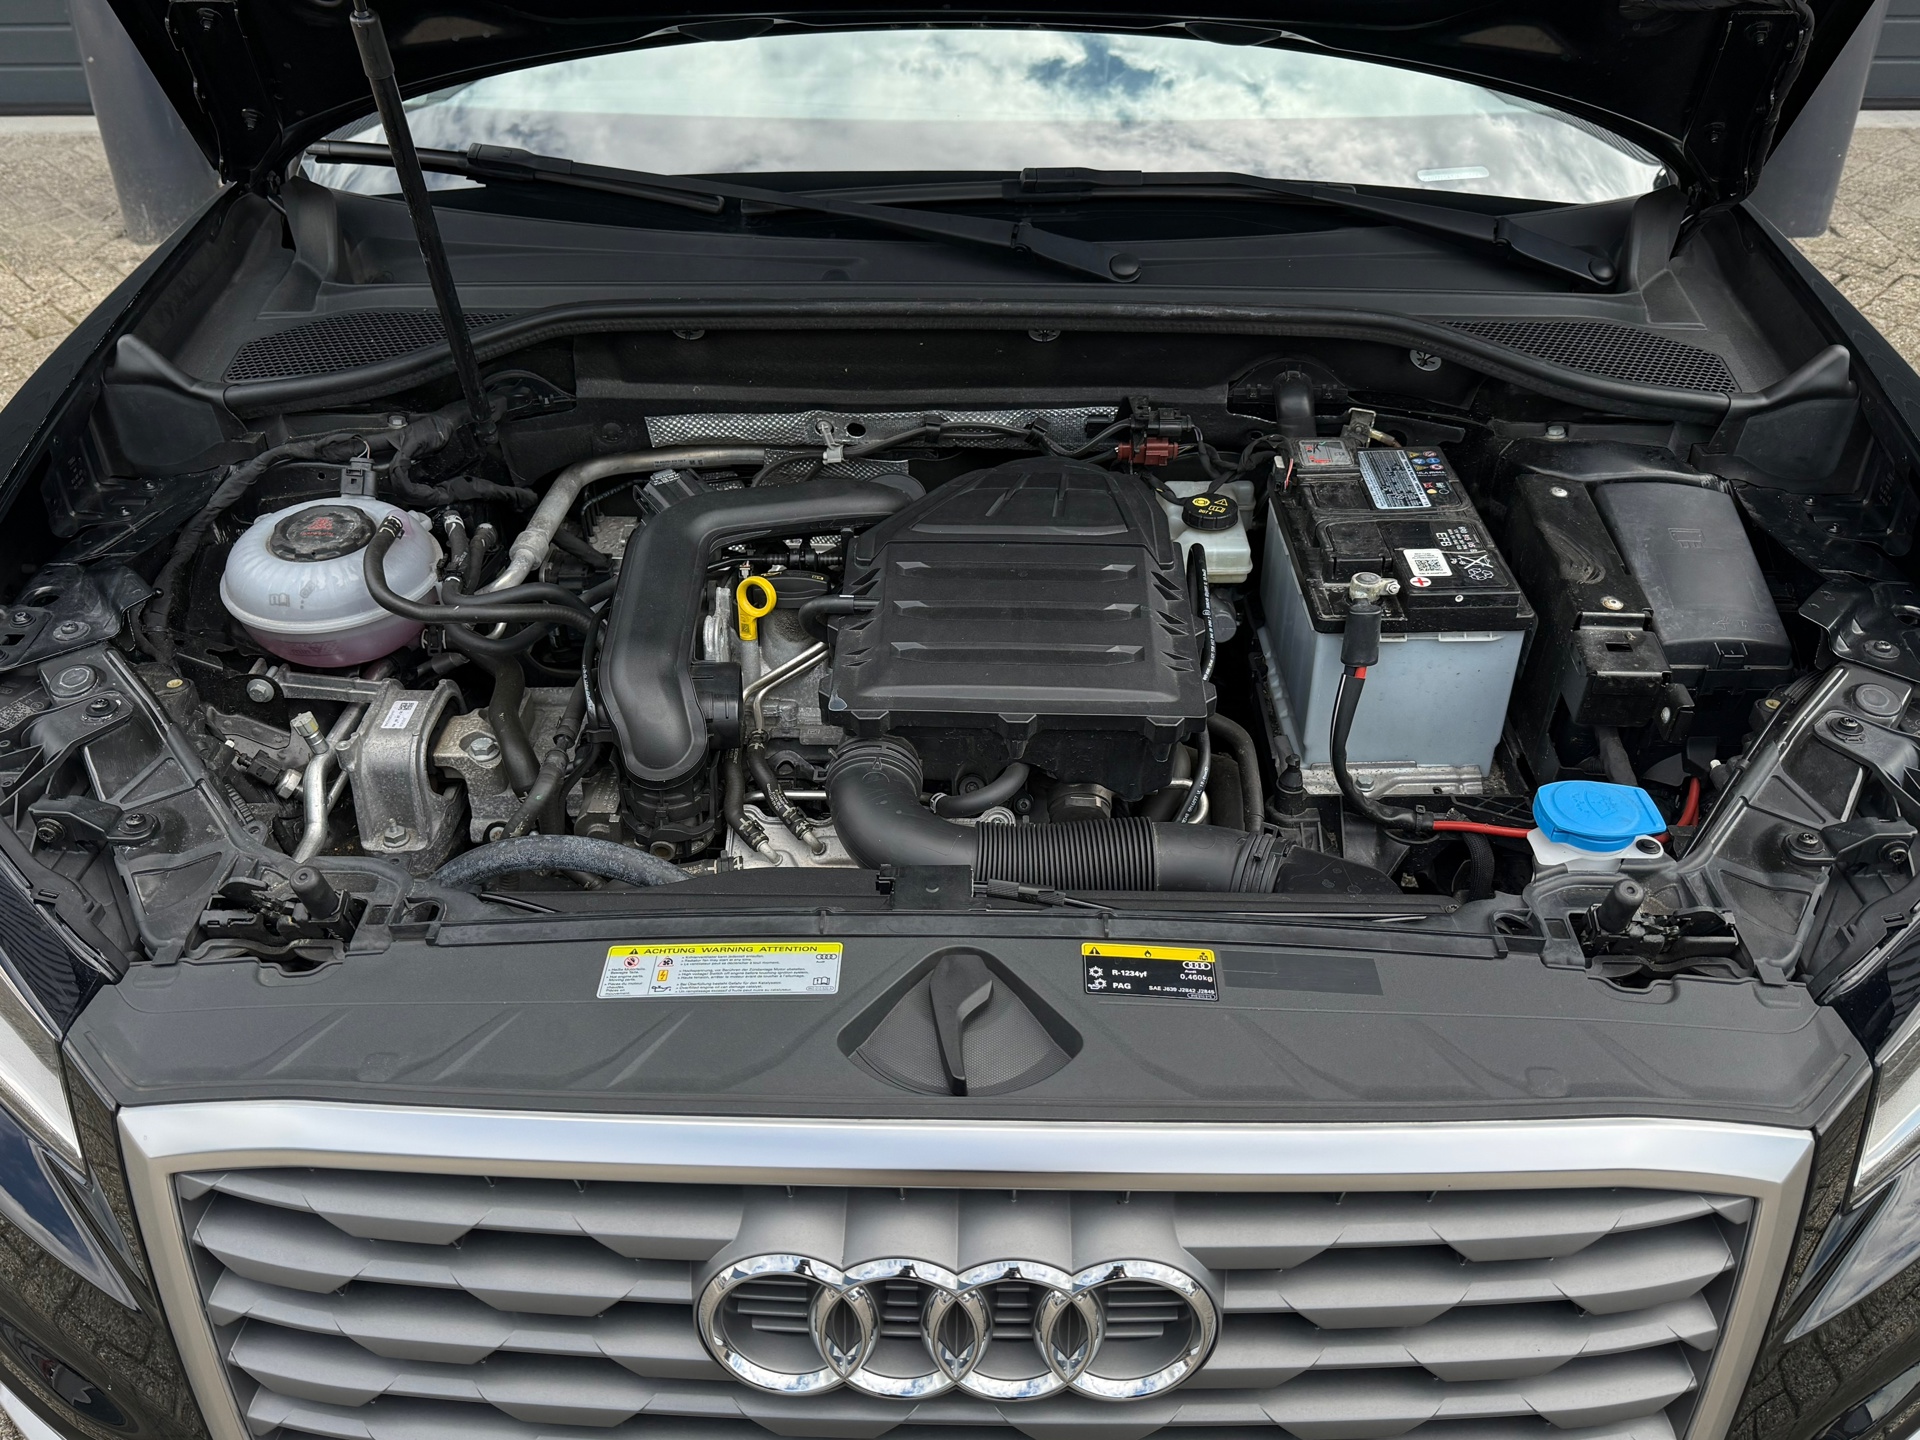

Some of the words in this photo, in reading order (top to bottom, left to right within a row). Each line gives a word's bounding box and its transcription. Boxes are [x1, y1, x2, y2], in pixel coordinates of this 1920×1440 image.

[1435, 532, 1453, 547] EFB
[701, 946, 754, 954] WARNING
[1111, 969, 1147, 978] R-1234yf
[1112, 982, 1131, 990] PAG
